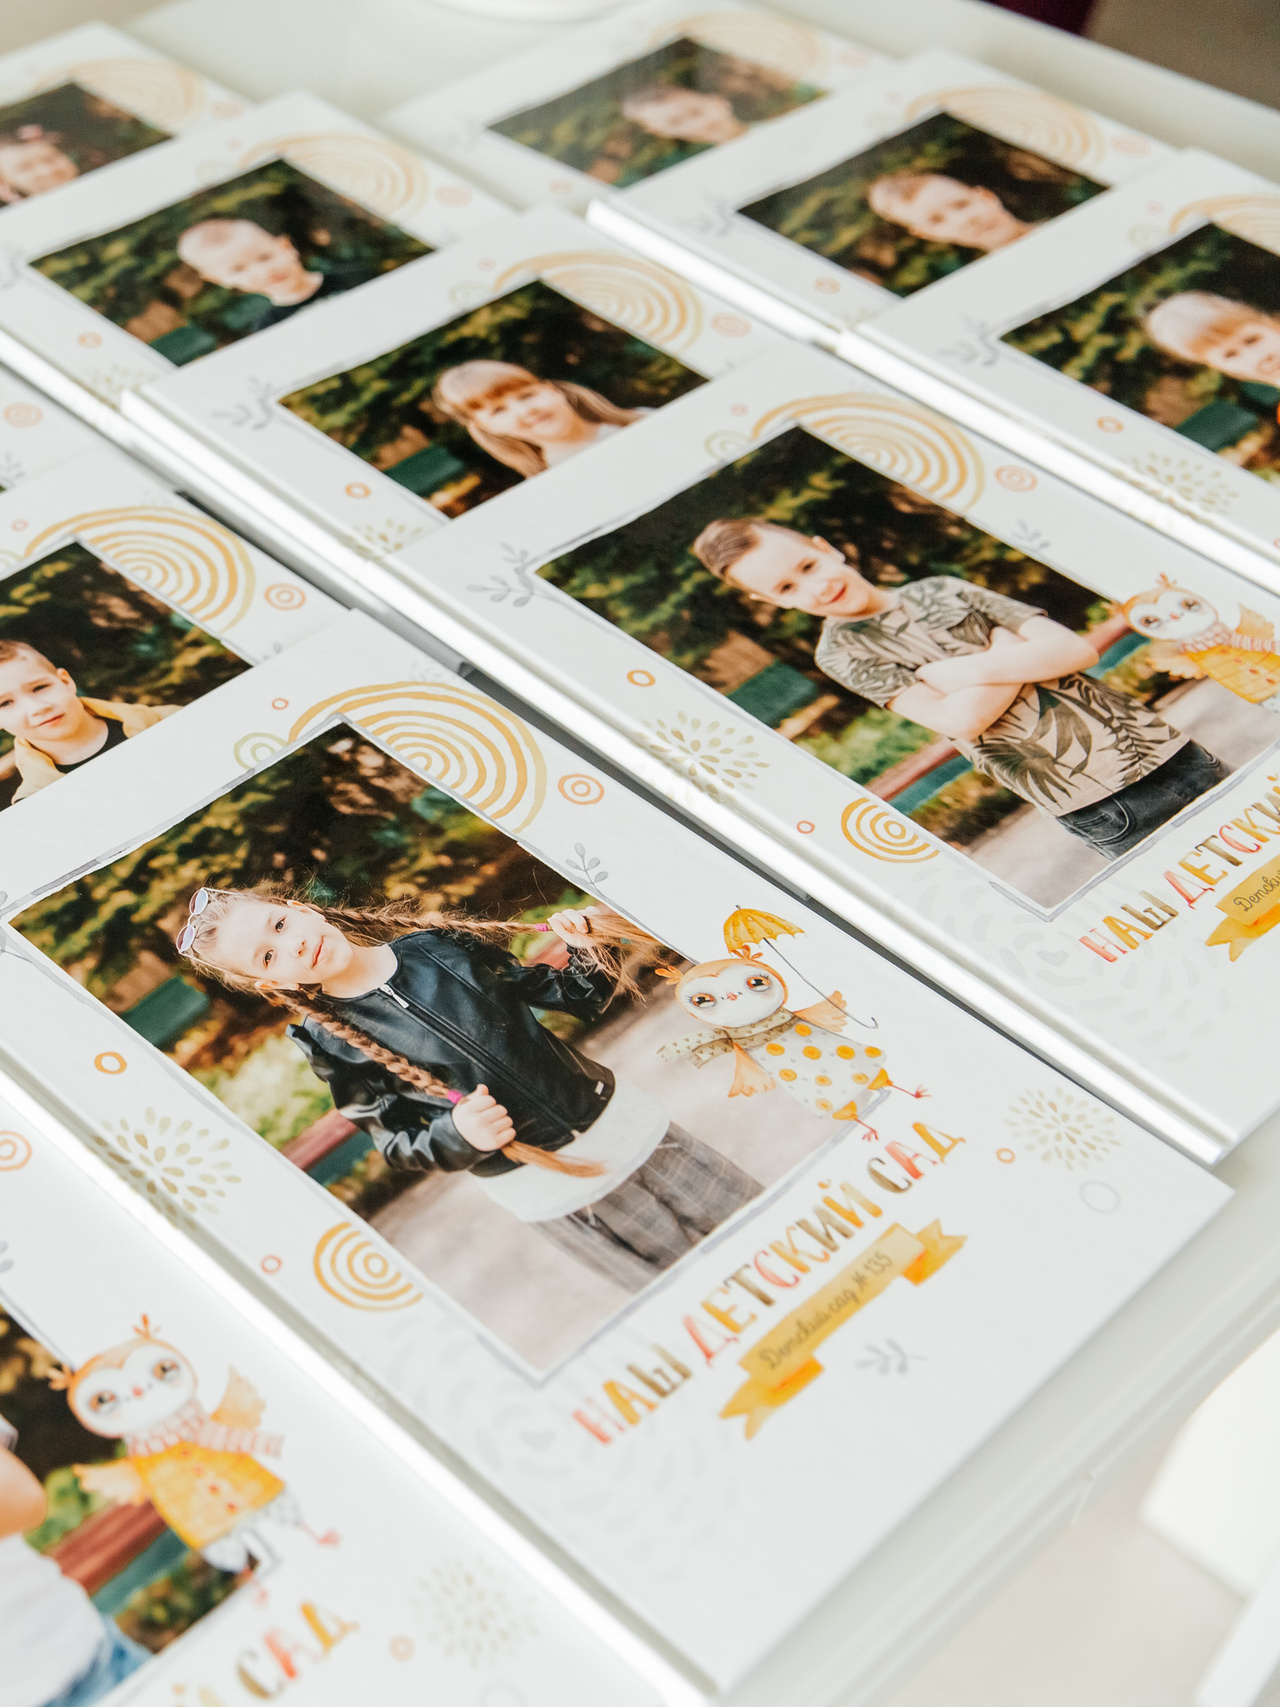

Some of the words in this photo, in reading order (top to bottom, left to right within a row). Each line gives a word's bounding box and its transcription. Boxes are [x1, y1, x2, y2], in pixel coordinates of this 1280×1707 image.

[1078, 890, 1179, 963] НАШ
[572, 1343, 692, 1444] НАШ
[682, 1178, 883, 1367] ДЕТСКИЙ
[867, 1122, 967, 1193] САД
[236, 1600, 360, 1701] САД
